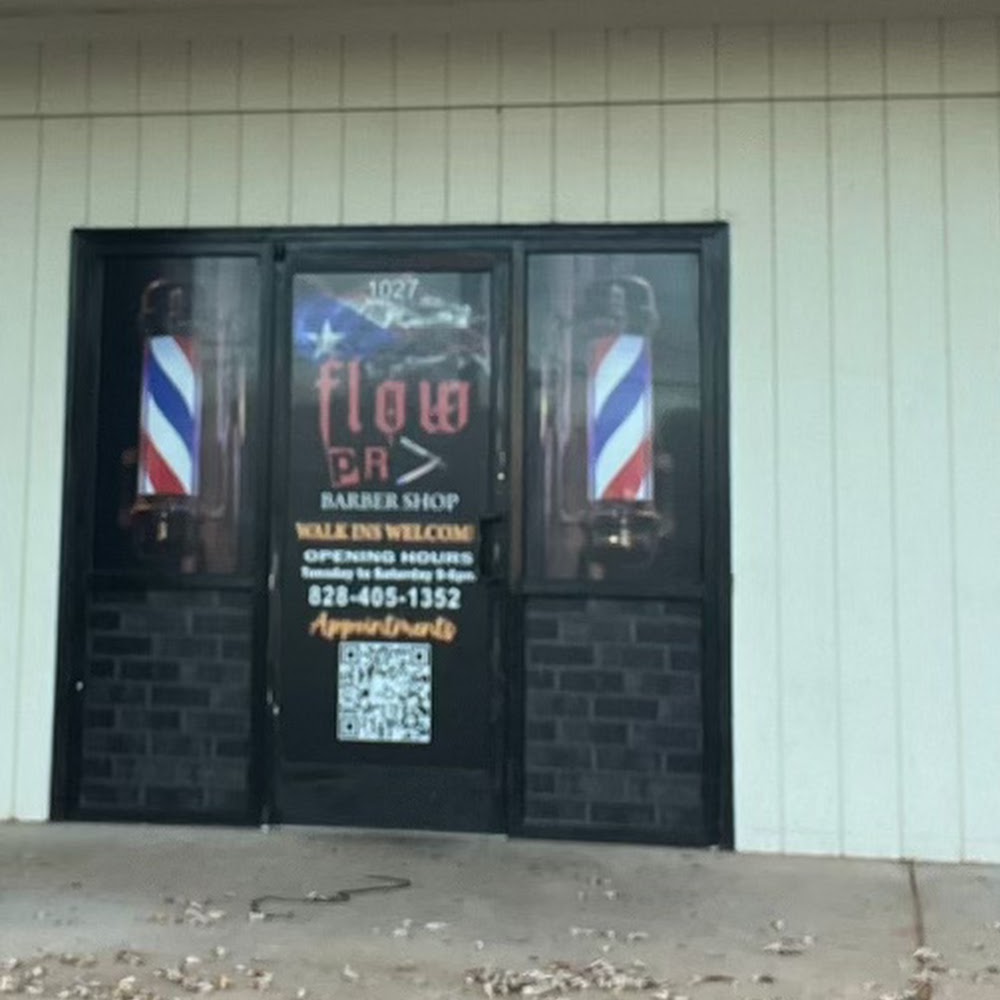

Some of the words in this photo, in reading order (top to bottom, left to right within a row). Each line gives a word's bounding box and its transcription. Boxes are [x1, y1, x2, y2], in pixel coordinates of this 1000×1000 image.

[369, 278, 420, 299] 1027
[315, 358, 469, 448] flow
[320, 491, 398, 511] BARBER
[401, 491, 460, 512] SHOP
[295, 522, 349, 541] WALK
[351, 523, 383, 541] INS
[303, 549, 397, 564] OPENING
[400, 551, 474, 565] HOURS
[308, 584, 462, 609] 828-405-1352
